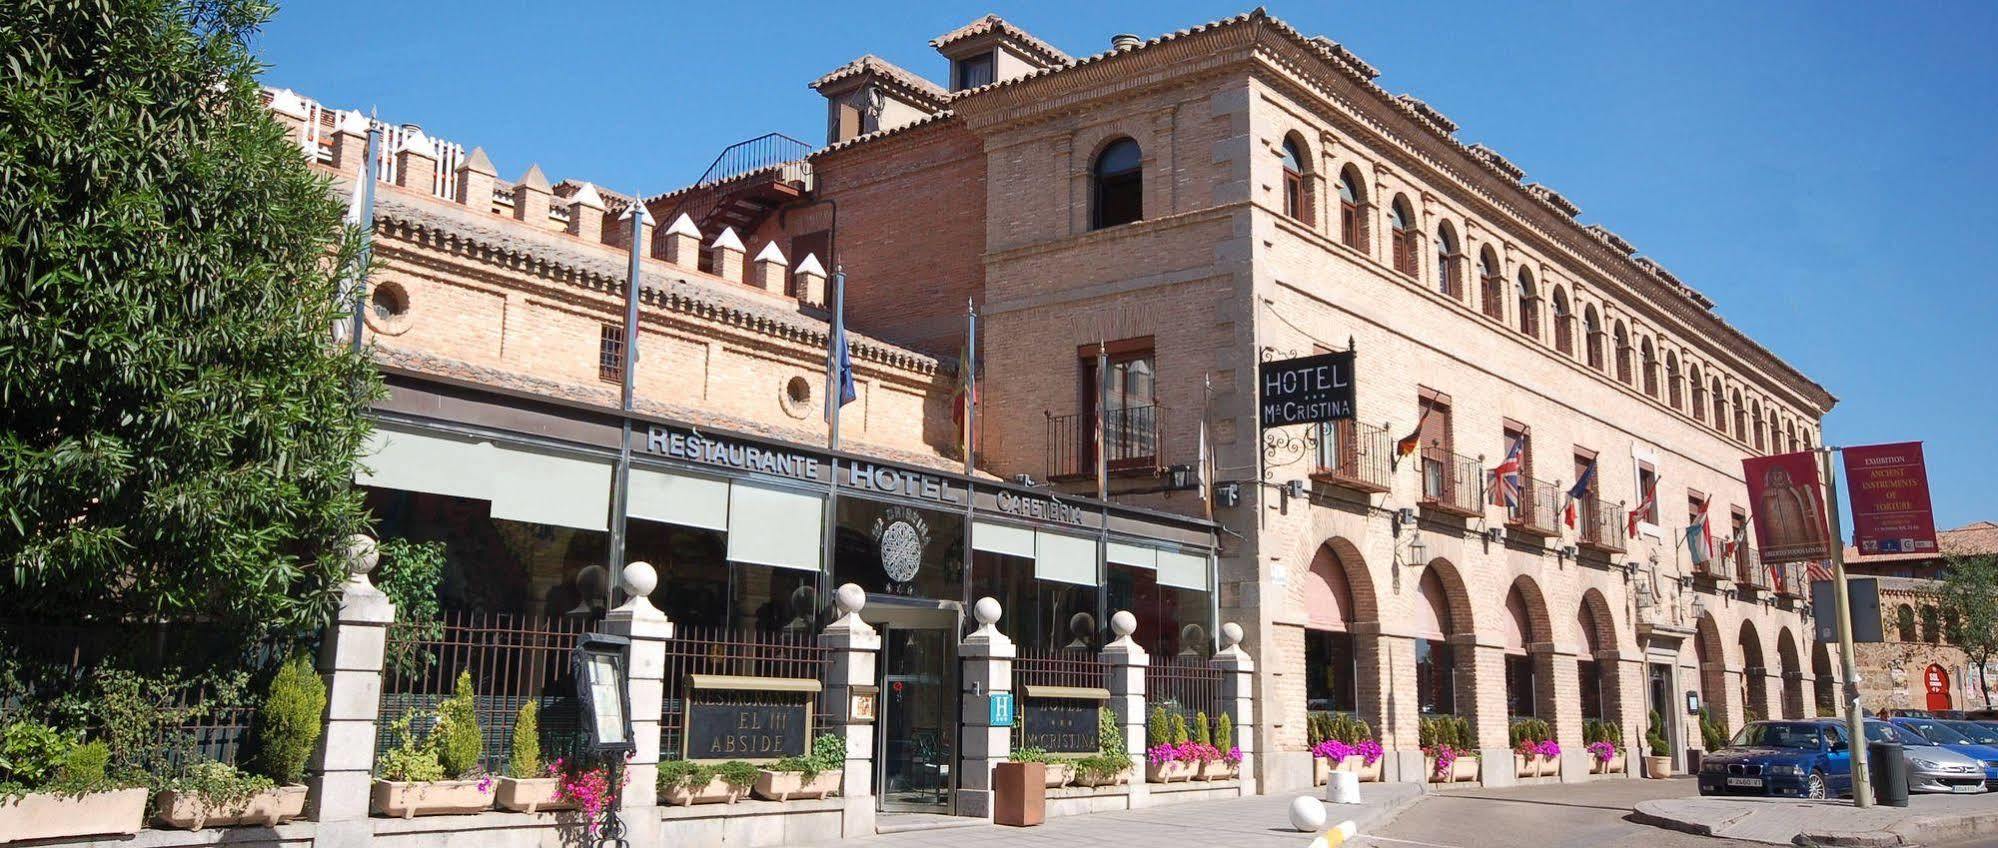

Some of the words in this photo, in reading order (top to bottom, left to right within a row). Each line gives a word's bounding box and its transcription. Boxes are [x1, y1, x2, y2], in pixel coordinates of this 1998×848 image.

[1266, 365, 1347, 396] HOTEL
[1865, 456, 1905, 465] EXHIBITION
[1870, 468, 1904, 478] ANCIENT
[850, 461, 958, 503] HOTEL
[1874, 501, 1912, 512] TORTURE
[996, 696, 1008, 716] H
[738, 711, 760, 729] EL
[710, 735, 784, 752] ABSIDE
